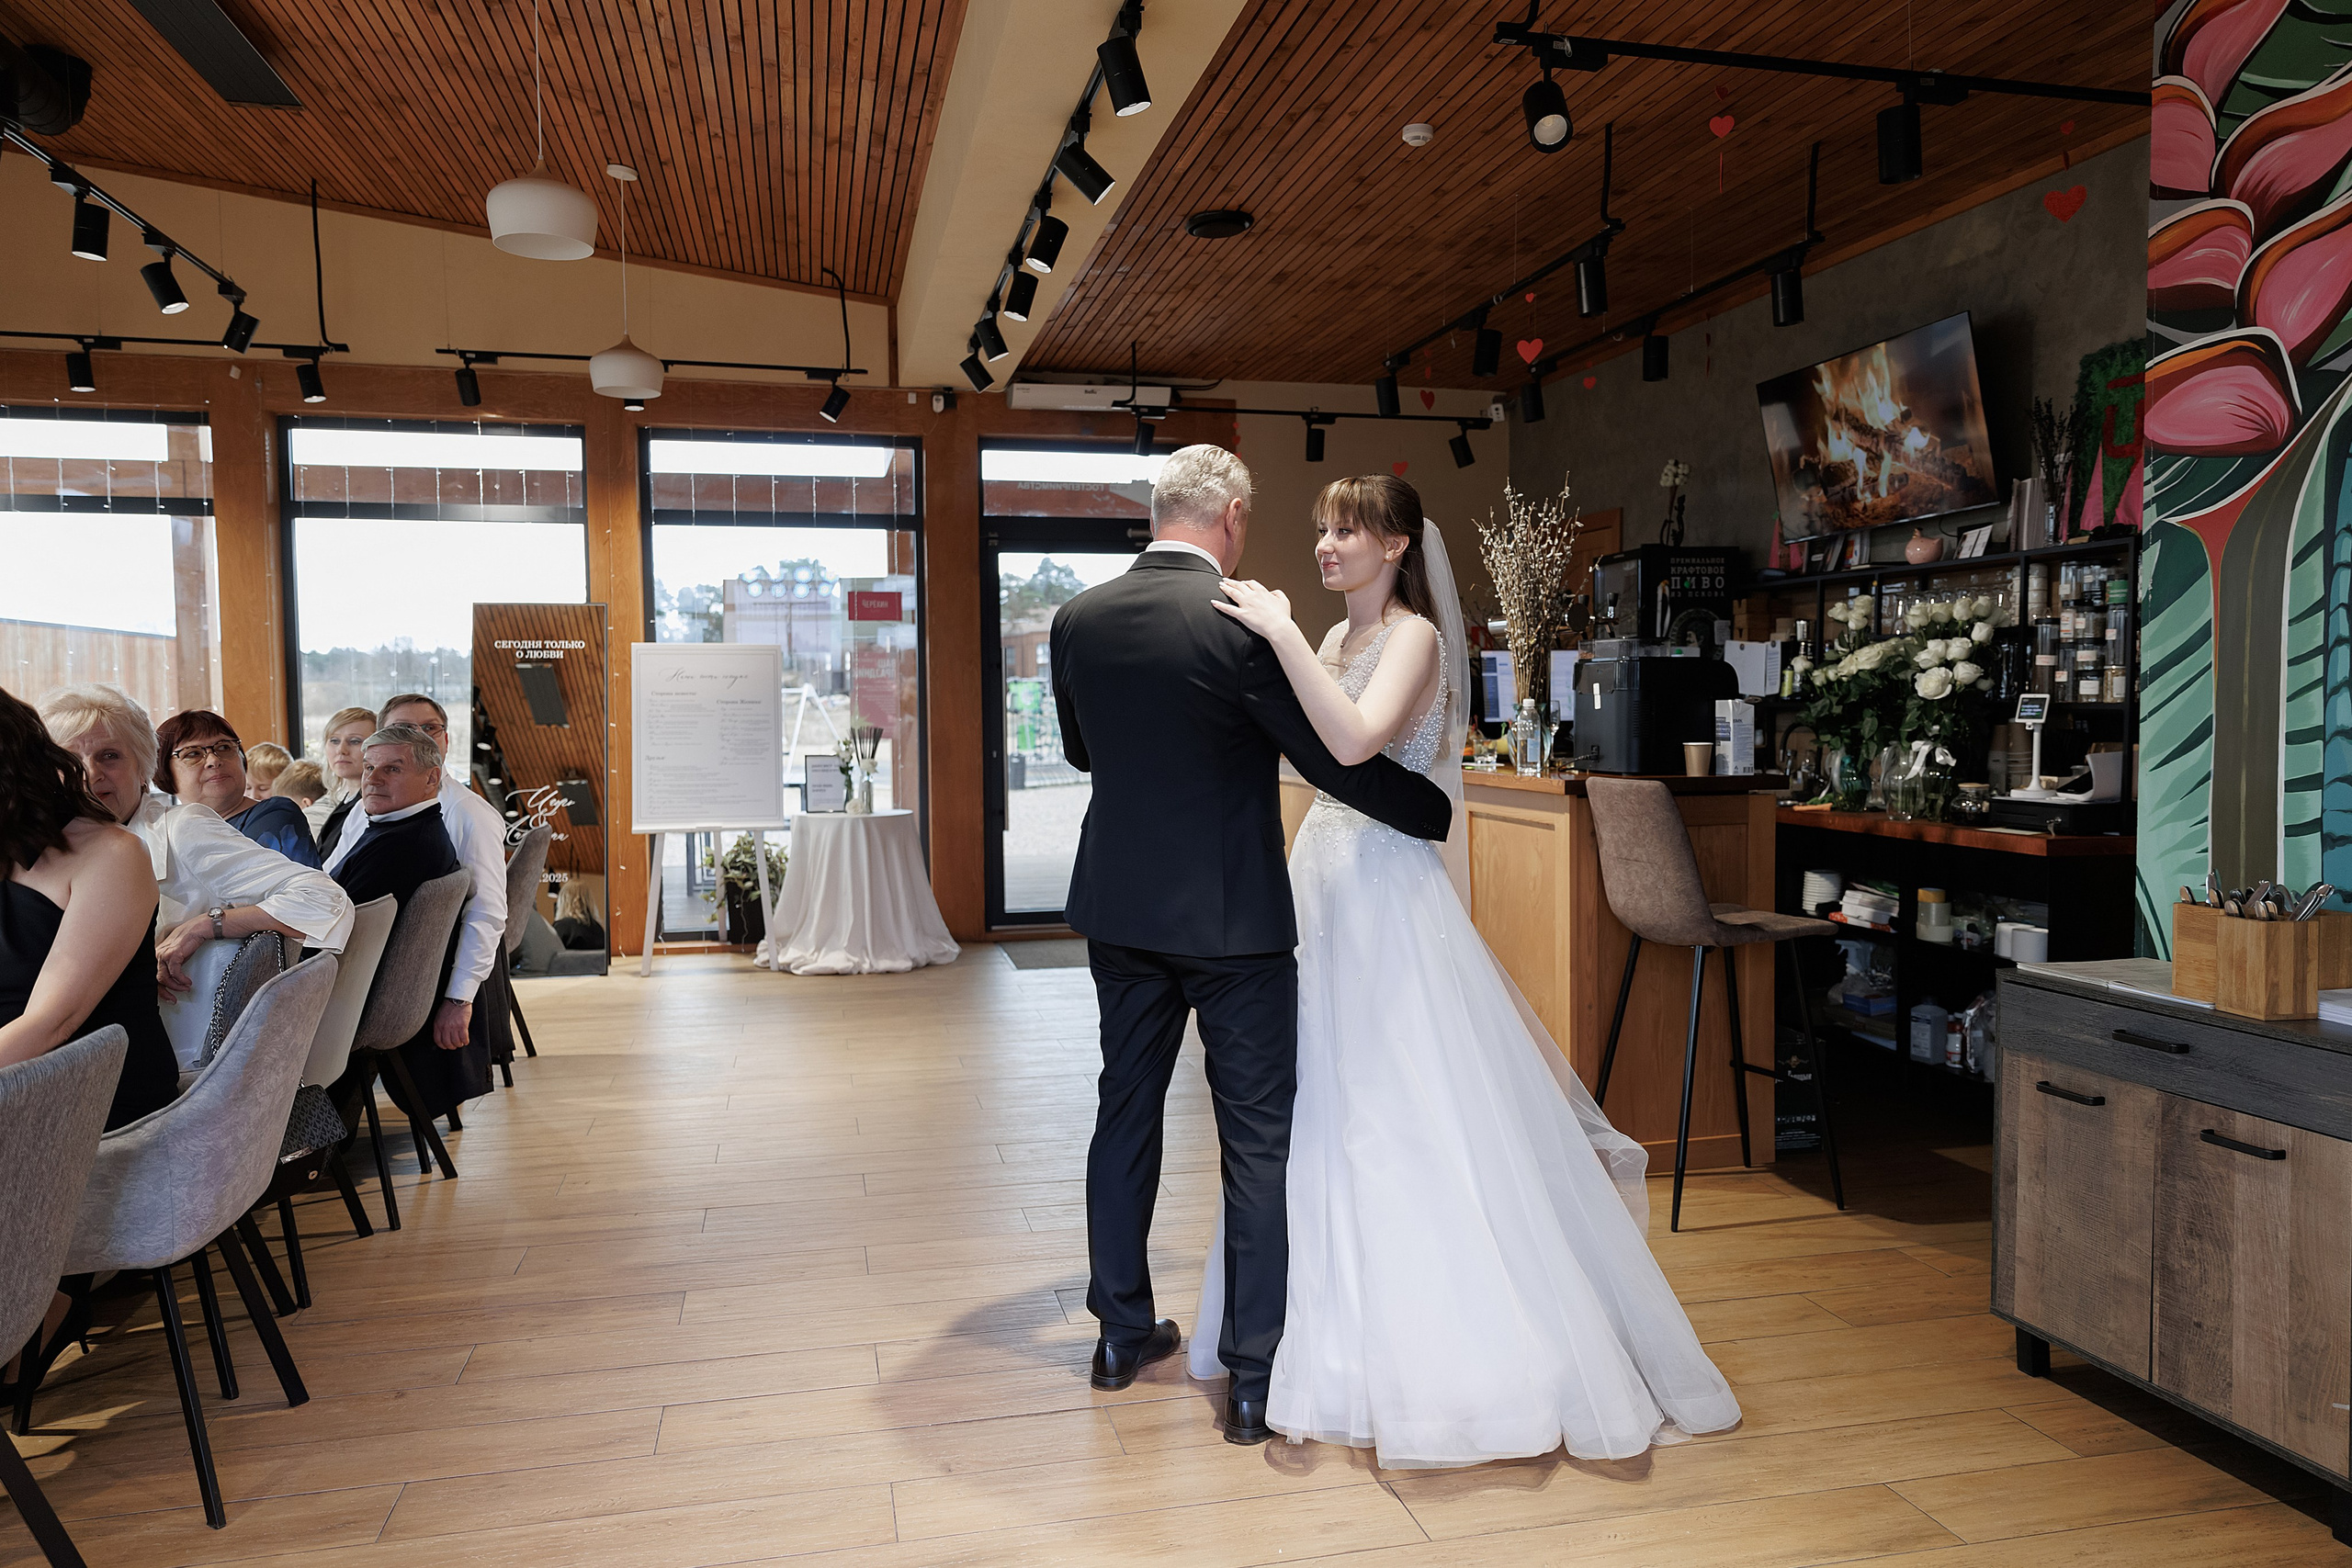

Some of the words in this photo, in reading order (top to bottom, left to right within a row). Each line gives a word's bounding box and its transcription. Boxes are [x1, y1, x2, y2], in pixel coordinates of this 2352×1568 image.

[1670, 566, 1725, 575] КРАФТОВОЕ
[1670, 576, 1724, 589] ПИВО
[493, 639, 541, 649] СЕГОДНЯ
[544, 639, 586, 649] ТОЛЬКО
[515, 649, 524, 659] О
[526, 649, 564, 660] ЛЮБВИ
